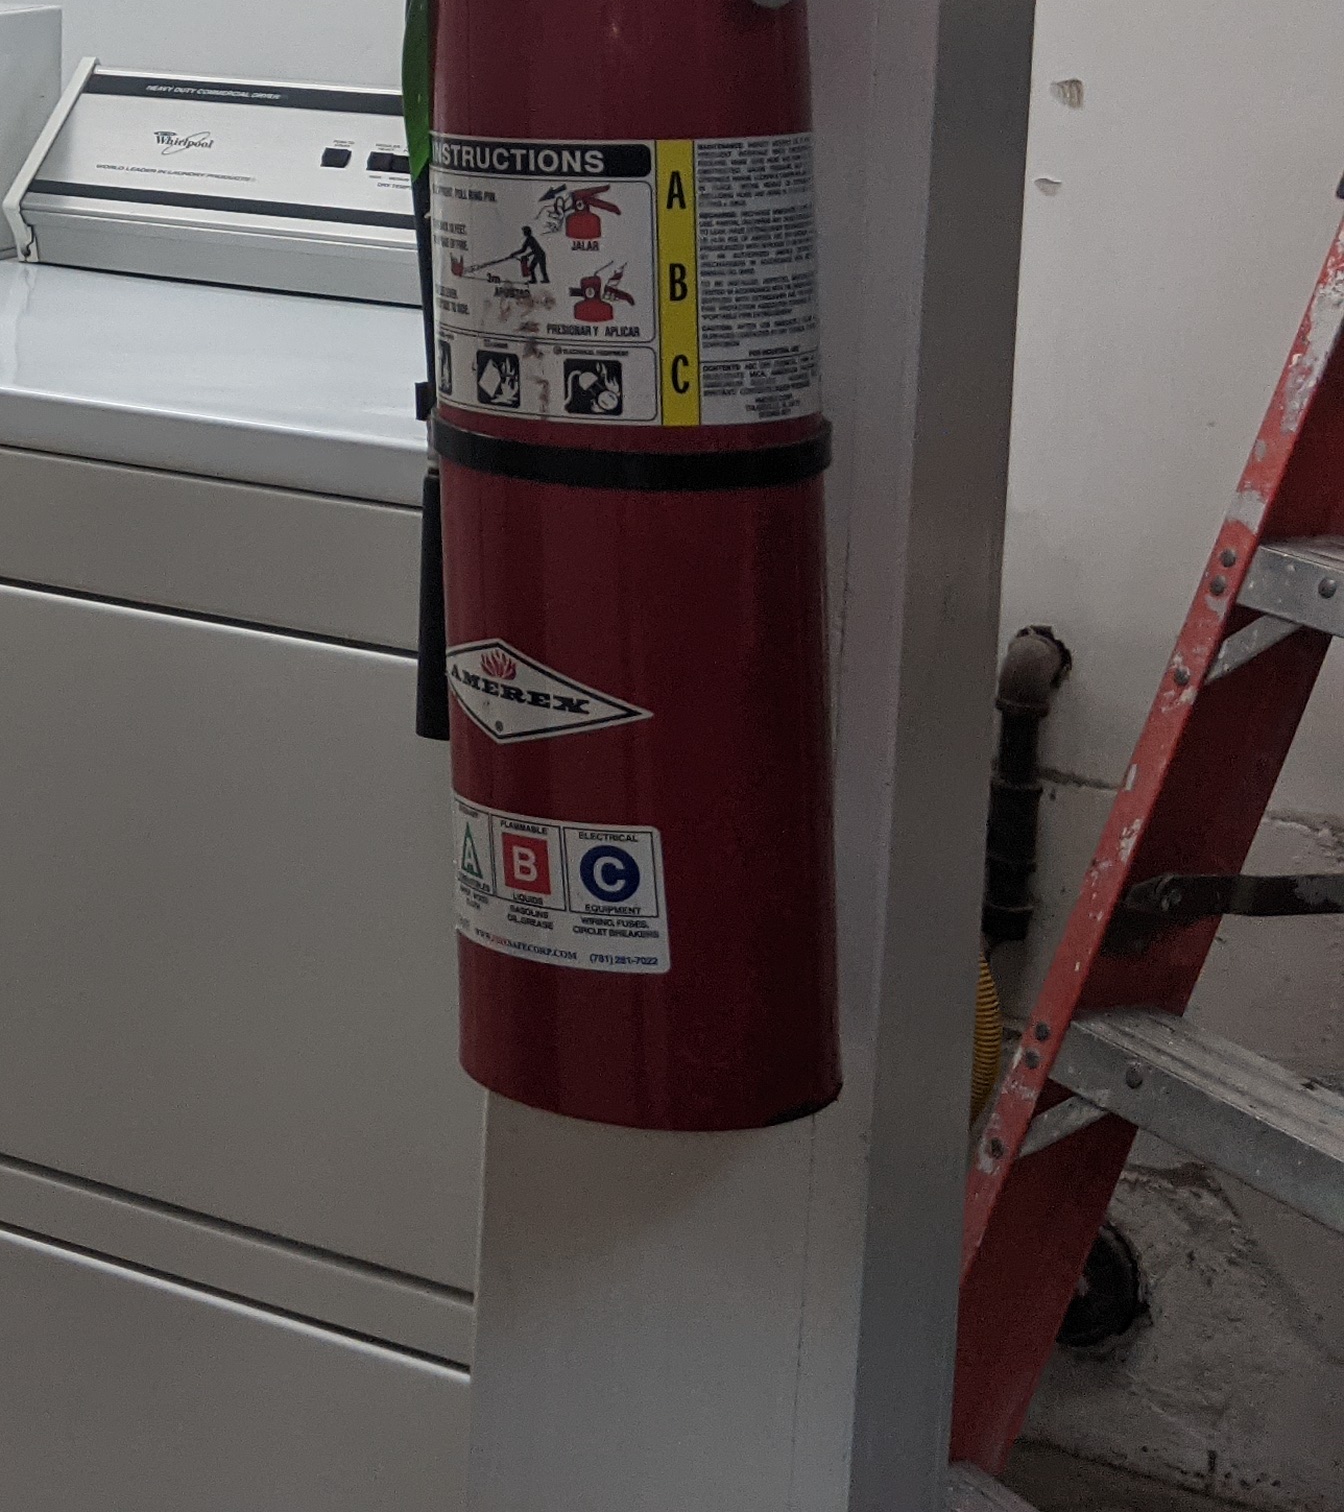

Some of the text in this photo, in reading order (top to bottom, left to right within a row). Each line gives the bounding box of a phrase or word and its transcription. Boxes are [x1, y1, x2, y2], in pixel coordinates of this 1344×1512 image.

[156, 134, 214, 149] Whirlpool
[433, 141, 605, 174] INSTRUCTIONS
[667, 170, 686, 210] A
[571, 240, 599, 252] JALAR
[669, 263, 688, 302] B
[547, 322, 640, 337] PRESIONAR Y APLICAR
[671, 355, 690, 395] C
[451, 664, 590, 715] AMEREX
[500, 820, 548, 835] FLAMMABLE
[578, 831, 638, 843] ELECTRICAL
[513, 845, 538, 882] B
[593, 856, 626, 892] C
[585, 904, 641, 915] EQUIPMENT
[573, 925, 660, 939] CIRCUIT BREAKERS
